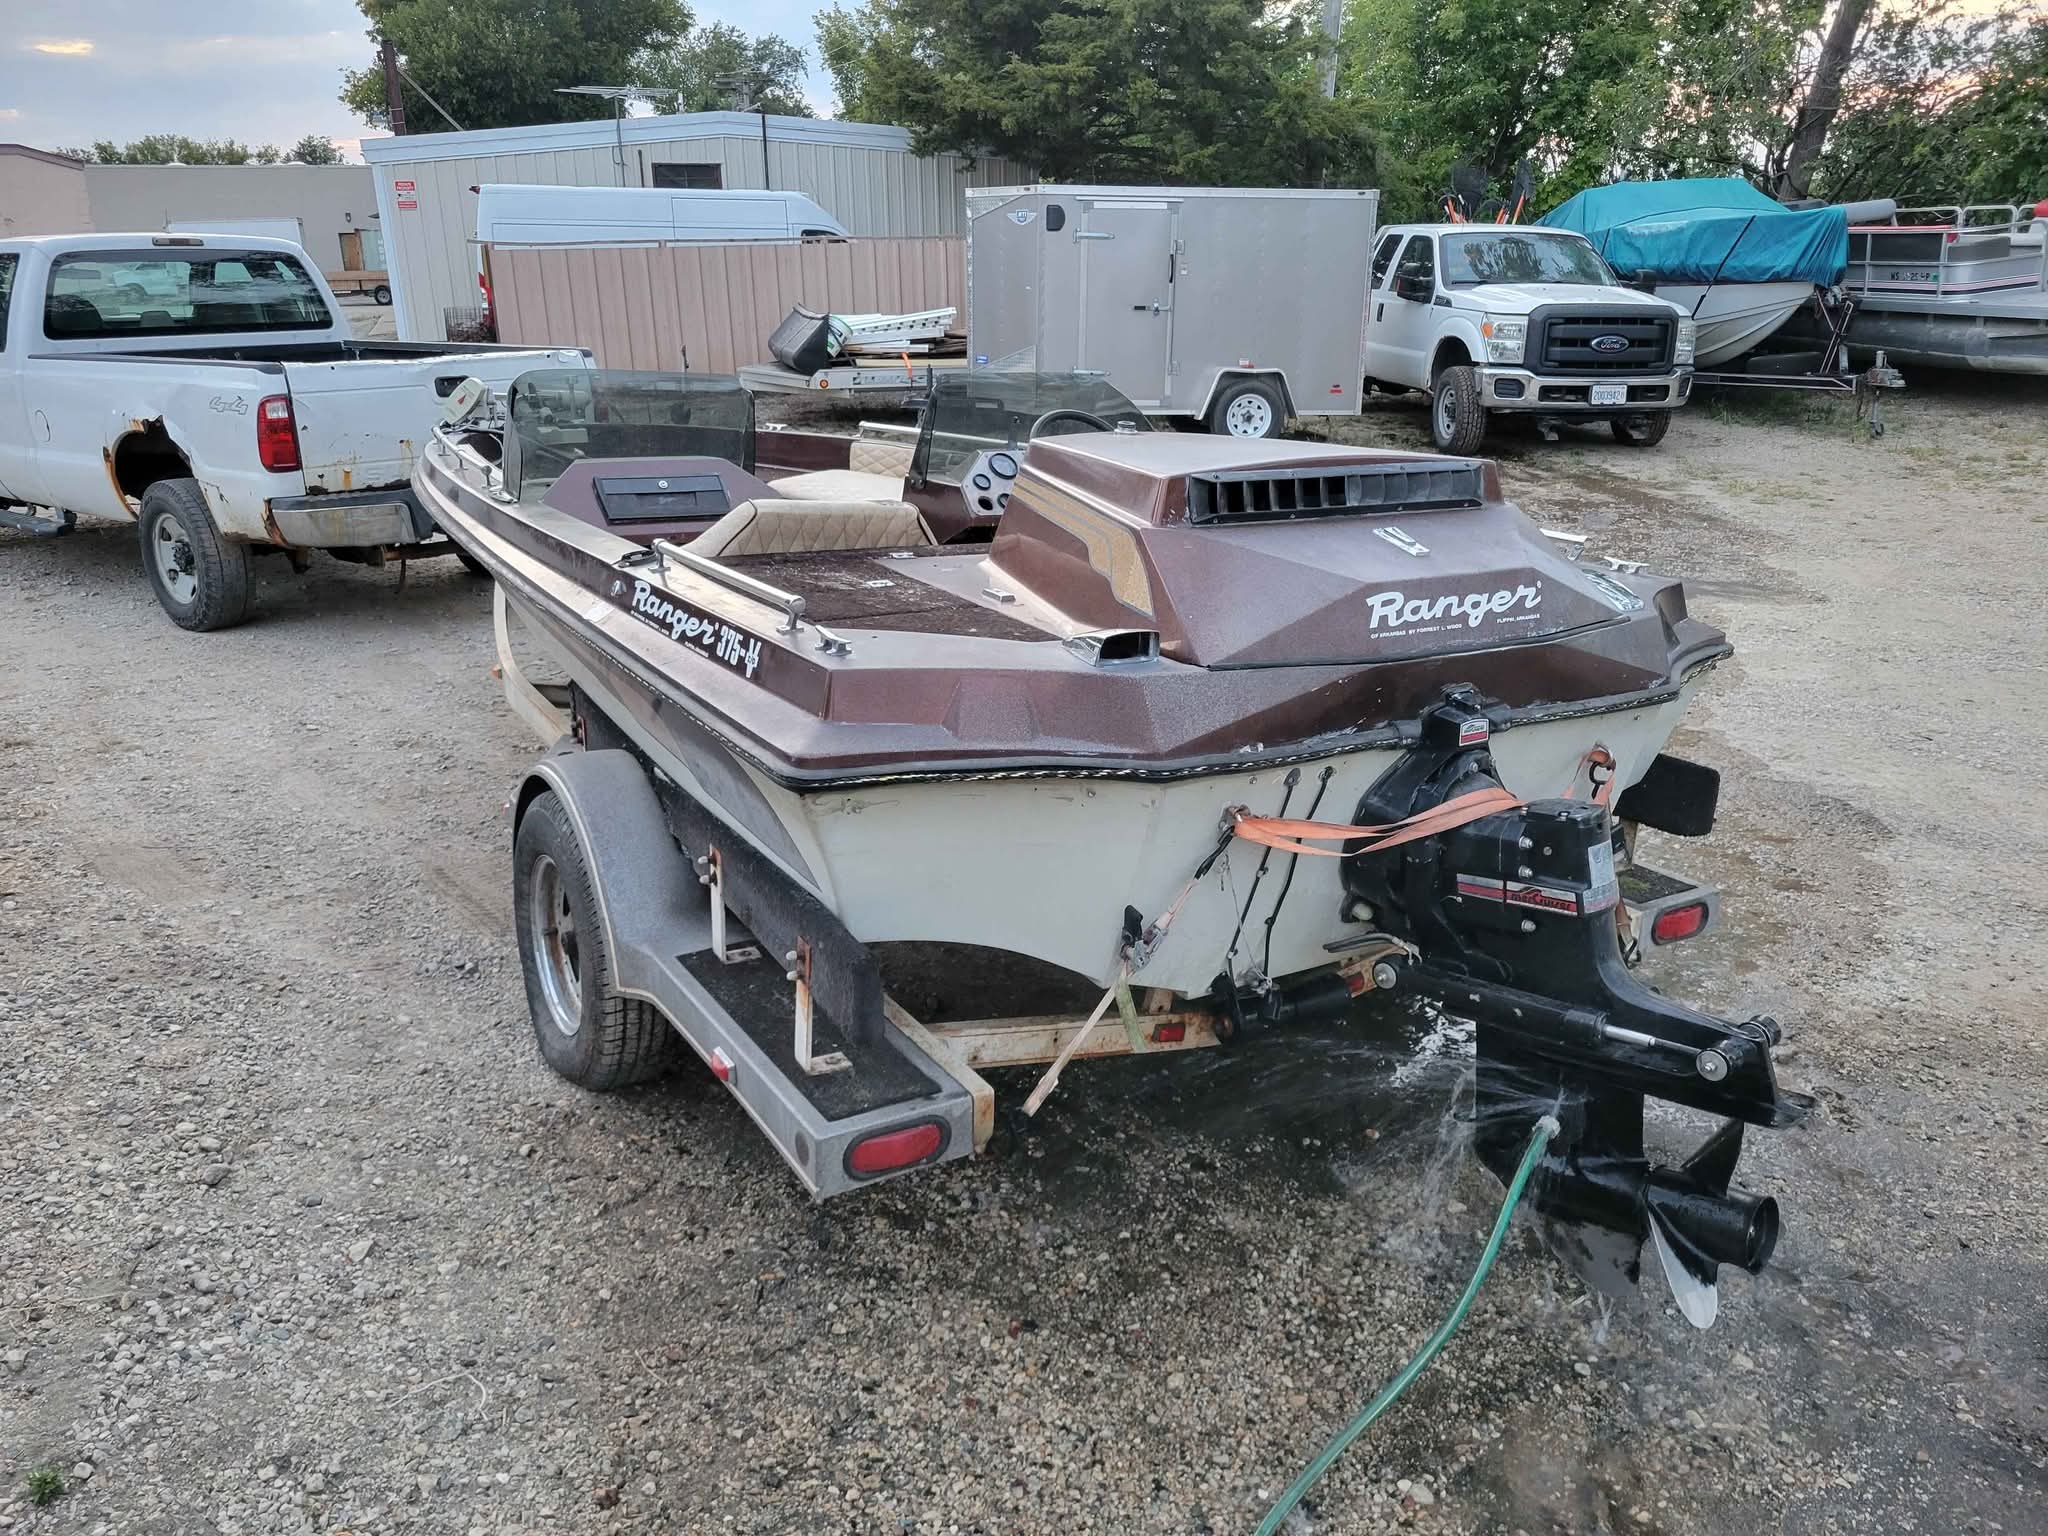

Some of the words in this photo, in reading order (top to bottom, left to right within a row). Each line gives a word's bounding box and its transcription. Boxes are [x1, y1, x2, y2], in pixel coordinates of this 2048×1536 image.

[209, 395, 249, 415] 4x4
[632, 580, 715, 645] Ranger
[1366, 584, 1542, 628] Ranger
